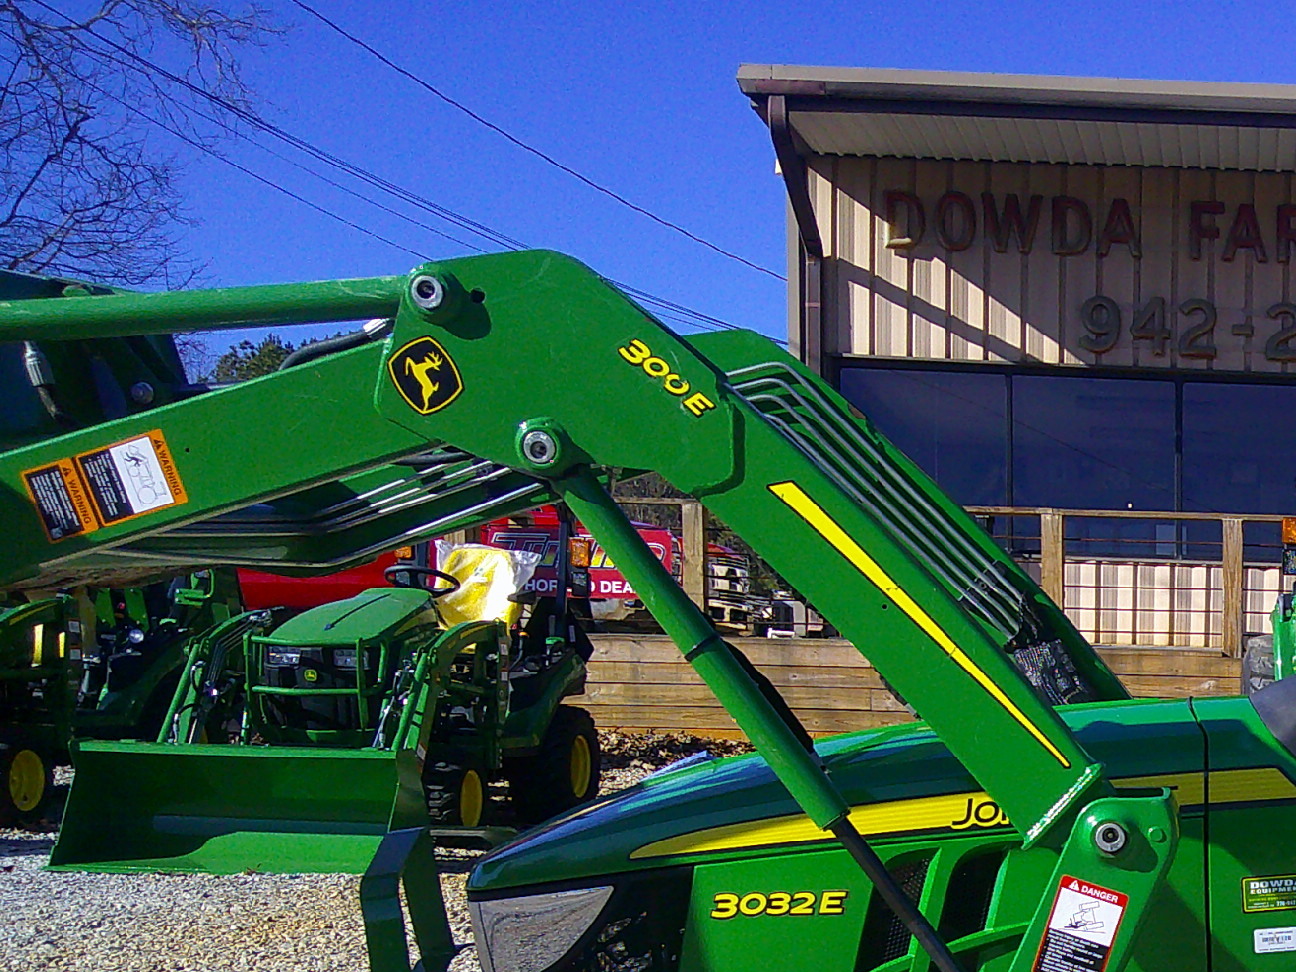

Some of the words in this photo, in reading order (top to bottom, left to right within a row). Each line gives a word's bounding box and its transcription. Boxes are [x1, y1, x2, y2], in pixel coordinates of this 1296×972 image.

[884, 189, 1141, 259] DOWDA
[158, 449, 183, 497] WARNING
[67, 478, 92, 525] WARNING
[1081, 885, 1119, 903] DANGER
